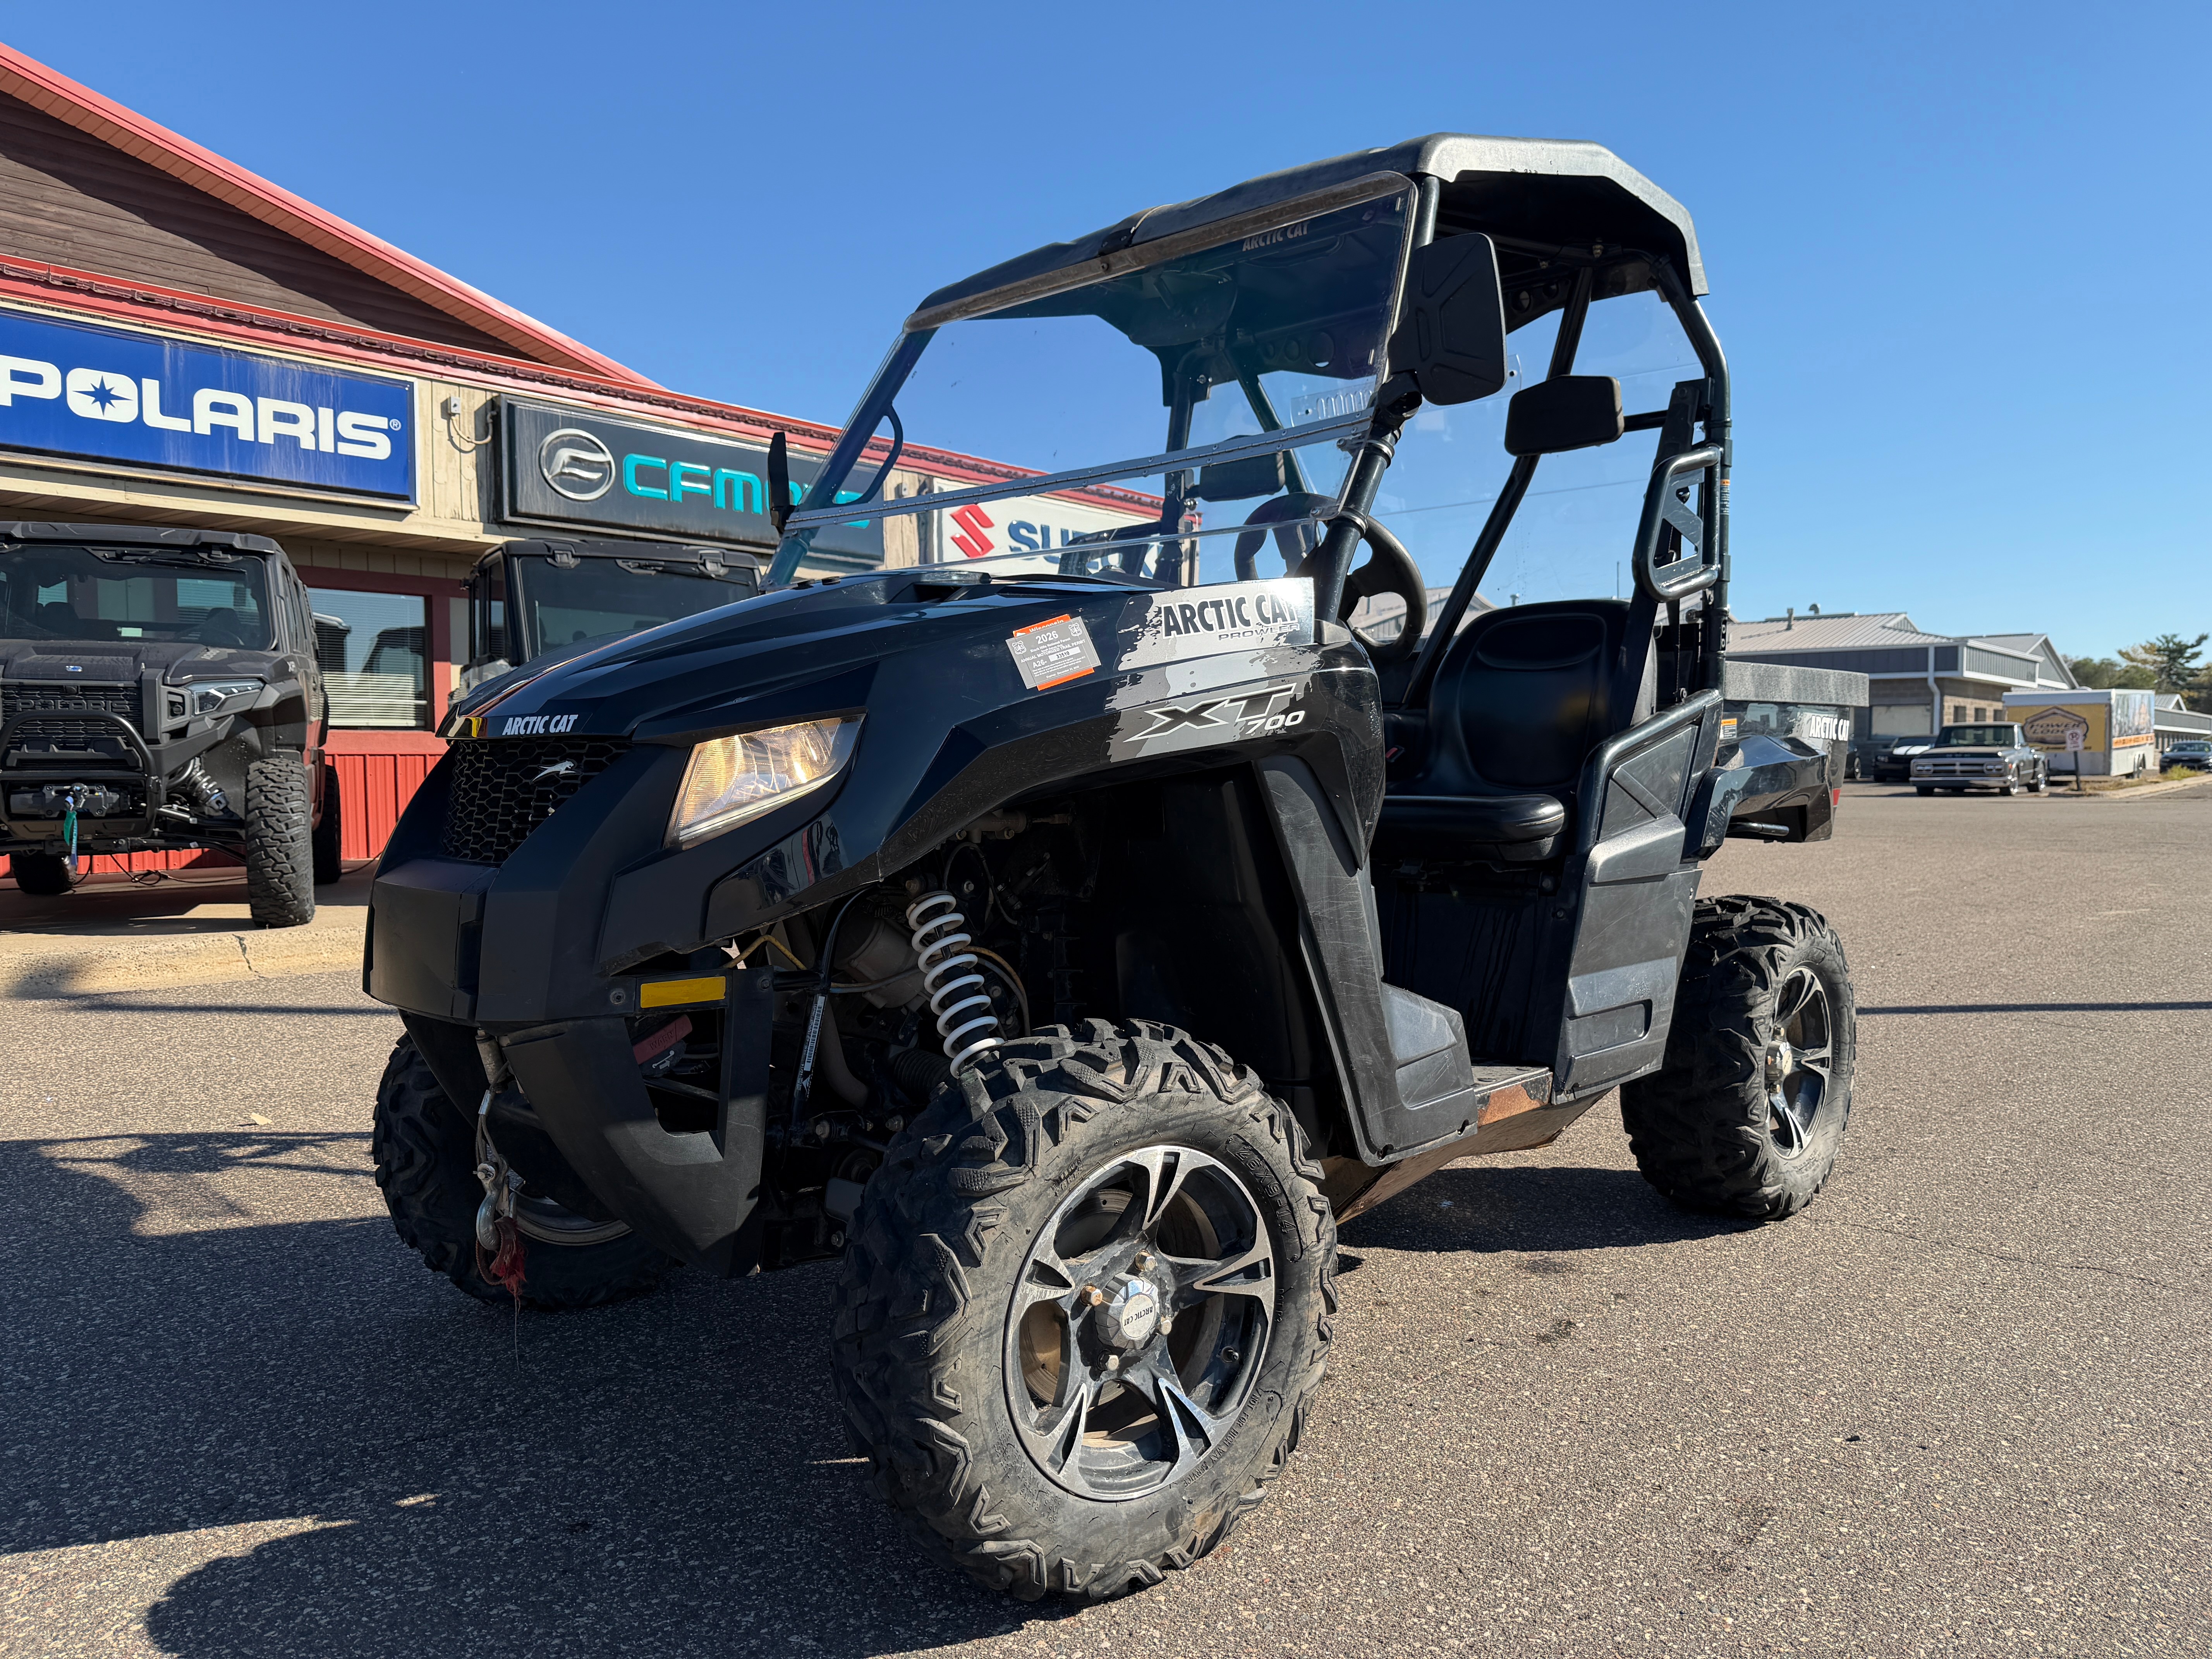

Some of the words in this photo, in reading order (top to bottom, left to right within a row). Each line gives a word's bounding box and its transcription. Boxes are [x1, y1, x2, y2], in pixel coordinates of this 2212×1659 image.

[1242, 228, 1284, 251] ARCTIC
[1286, 222, 1309, 239] CAT
[0, 355, 391, 460] POLARIS
[1163, 596, 1251, 637] ARCTIC
[1036, 630, 1058, 644] 2026
[1218, 623, 1300, 641] PROWLER
[1021, 655, 1037, 663] ANNUAL
[1072, 639, 1085, 647] PERMIT
[16, 699, 130, 713] POLARIS
[1123, 683, 1297, 742] XT
[502, 715, 550, 735] ARCTIC
[549, 714, 579, 733] CAT
[1245, 710, 1305, 735] 700
[1809, 715, 1838, 740] ARCTIC
[1838, 719, 1850, 741] CAT
[650, 1031, 674, 1050] WARN
[1124, 1316, 1133, 1326] CAT
[1134, 1306, 1153, 1321] ARCTIC
[1247, 1394, 1259, 1410] NOT
[1236, 1412, 1249, 1428] FOR
[1183, 1461, 1209, 1487] SERVICE
